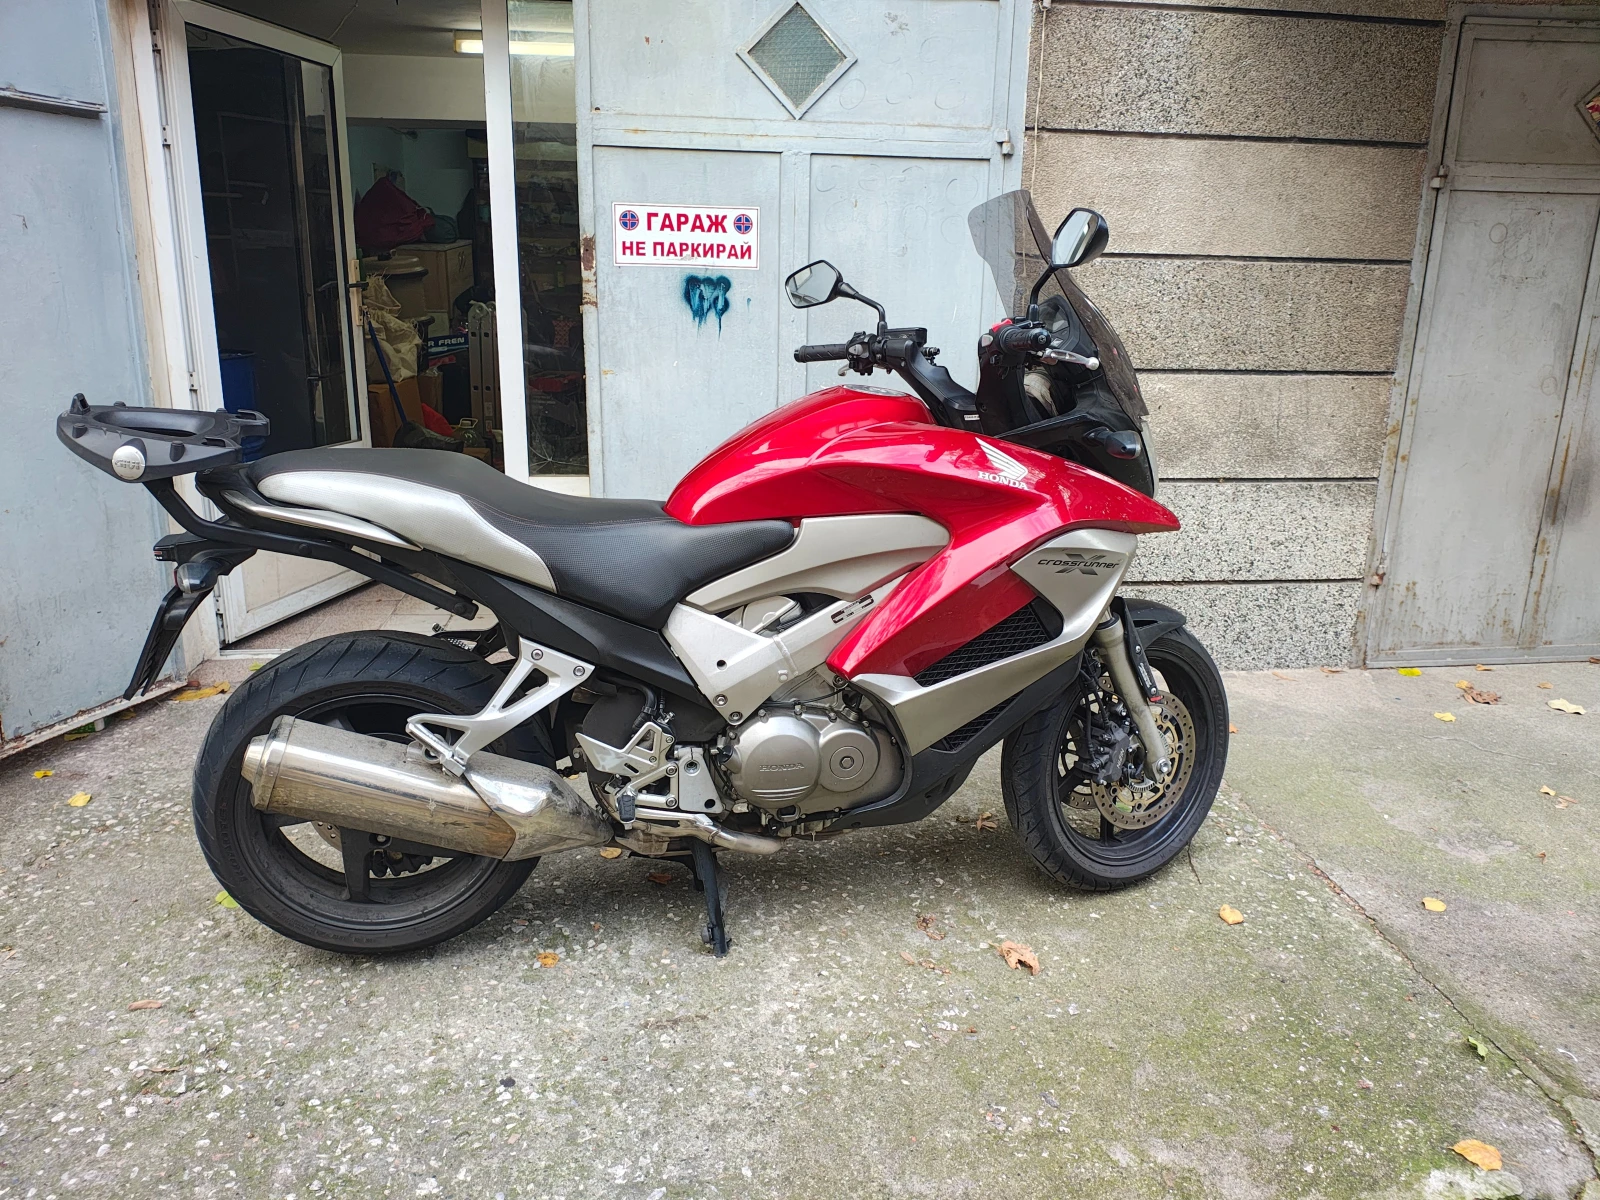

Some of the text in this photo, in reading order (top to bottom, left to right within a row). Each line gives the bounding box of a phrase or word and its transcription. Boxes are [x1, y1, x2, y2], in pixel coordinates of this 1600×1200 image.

[646, 212, 728, 234] ГАРАЖ
[621, 241, 752, 260] НЕ ПАРКИРАЙ
[977, 470, 1030, 490] HONDA
[1037, 559, 1120, 569] crossrunner
[759, 762, 805, 772] HONDA
